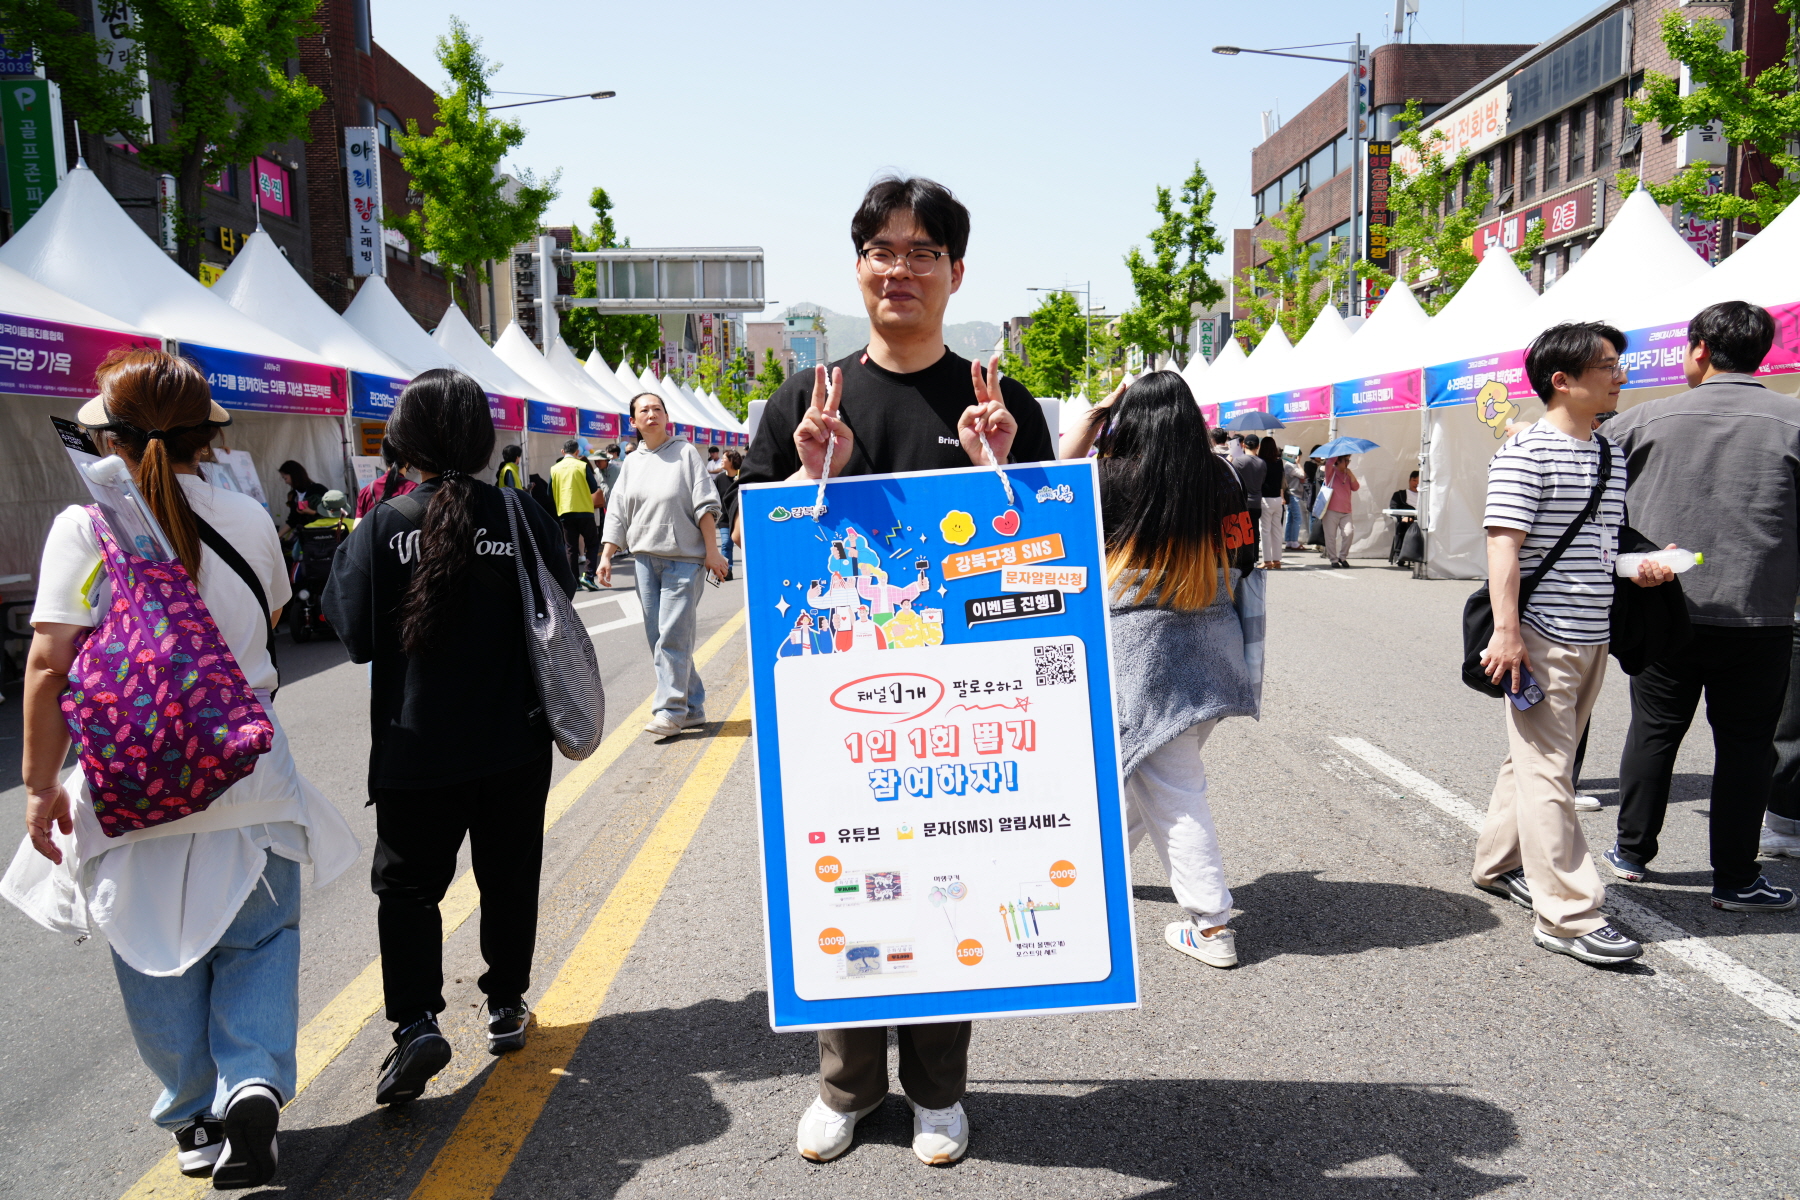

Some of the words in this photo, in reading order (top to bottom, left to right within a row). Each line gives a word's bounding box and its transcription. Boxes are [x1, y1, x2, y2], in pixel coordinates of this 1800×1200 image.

[1369, 145, 1390, 155] 허브
[350, 140, 375, 222] 아리랑
[1552, 200, 1576, 233] 2층
[37, 350, 72, 375] 가옥
[237, 375, 270, 394] 함께하는
[270, 380, 287, 395] 의류
[287, 381, 303, 397] 재생
[304, 383, 331, 399] 프로젝트
[938, 436, 960, 447] Bring
[955, 546, 1017, 573] 강북구청
[1022, 540, 1053, 559] SNS
[1006, 571, 1082, 586] 문자알림신청
[972, 598, 1017, 617] 이벤트
[1020, 593, 1056, 612] 진행!
[952, 679, 1023, 698] 팔로우하고
[844, 729, 896, 764] 1인
[907, 725, 960, 759] 1회
[972, 719, 1036, 755] 뽑기
[868, 760, 1019, 802] 참여하자!
[838, 826, 881, 844] 유튜브
[998, 812, 1072, 832] 알림서비스
[818, 864, 839, 874] 50명
[1050, 869, 1077, 880] 200명
[819, 936, 845, 946] 100명
[957, 946, 984, 957] 150명
